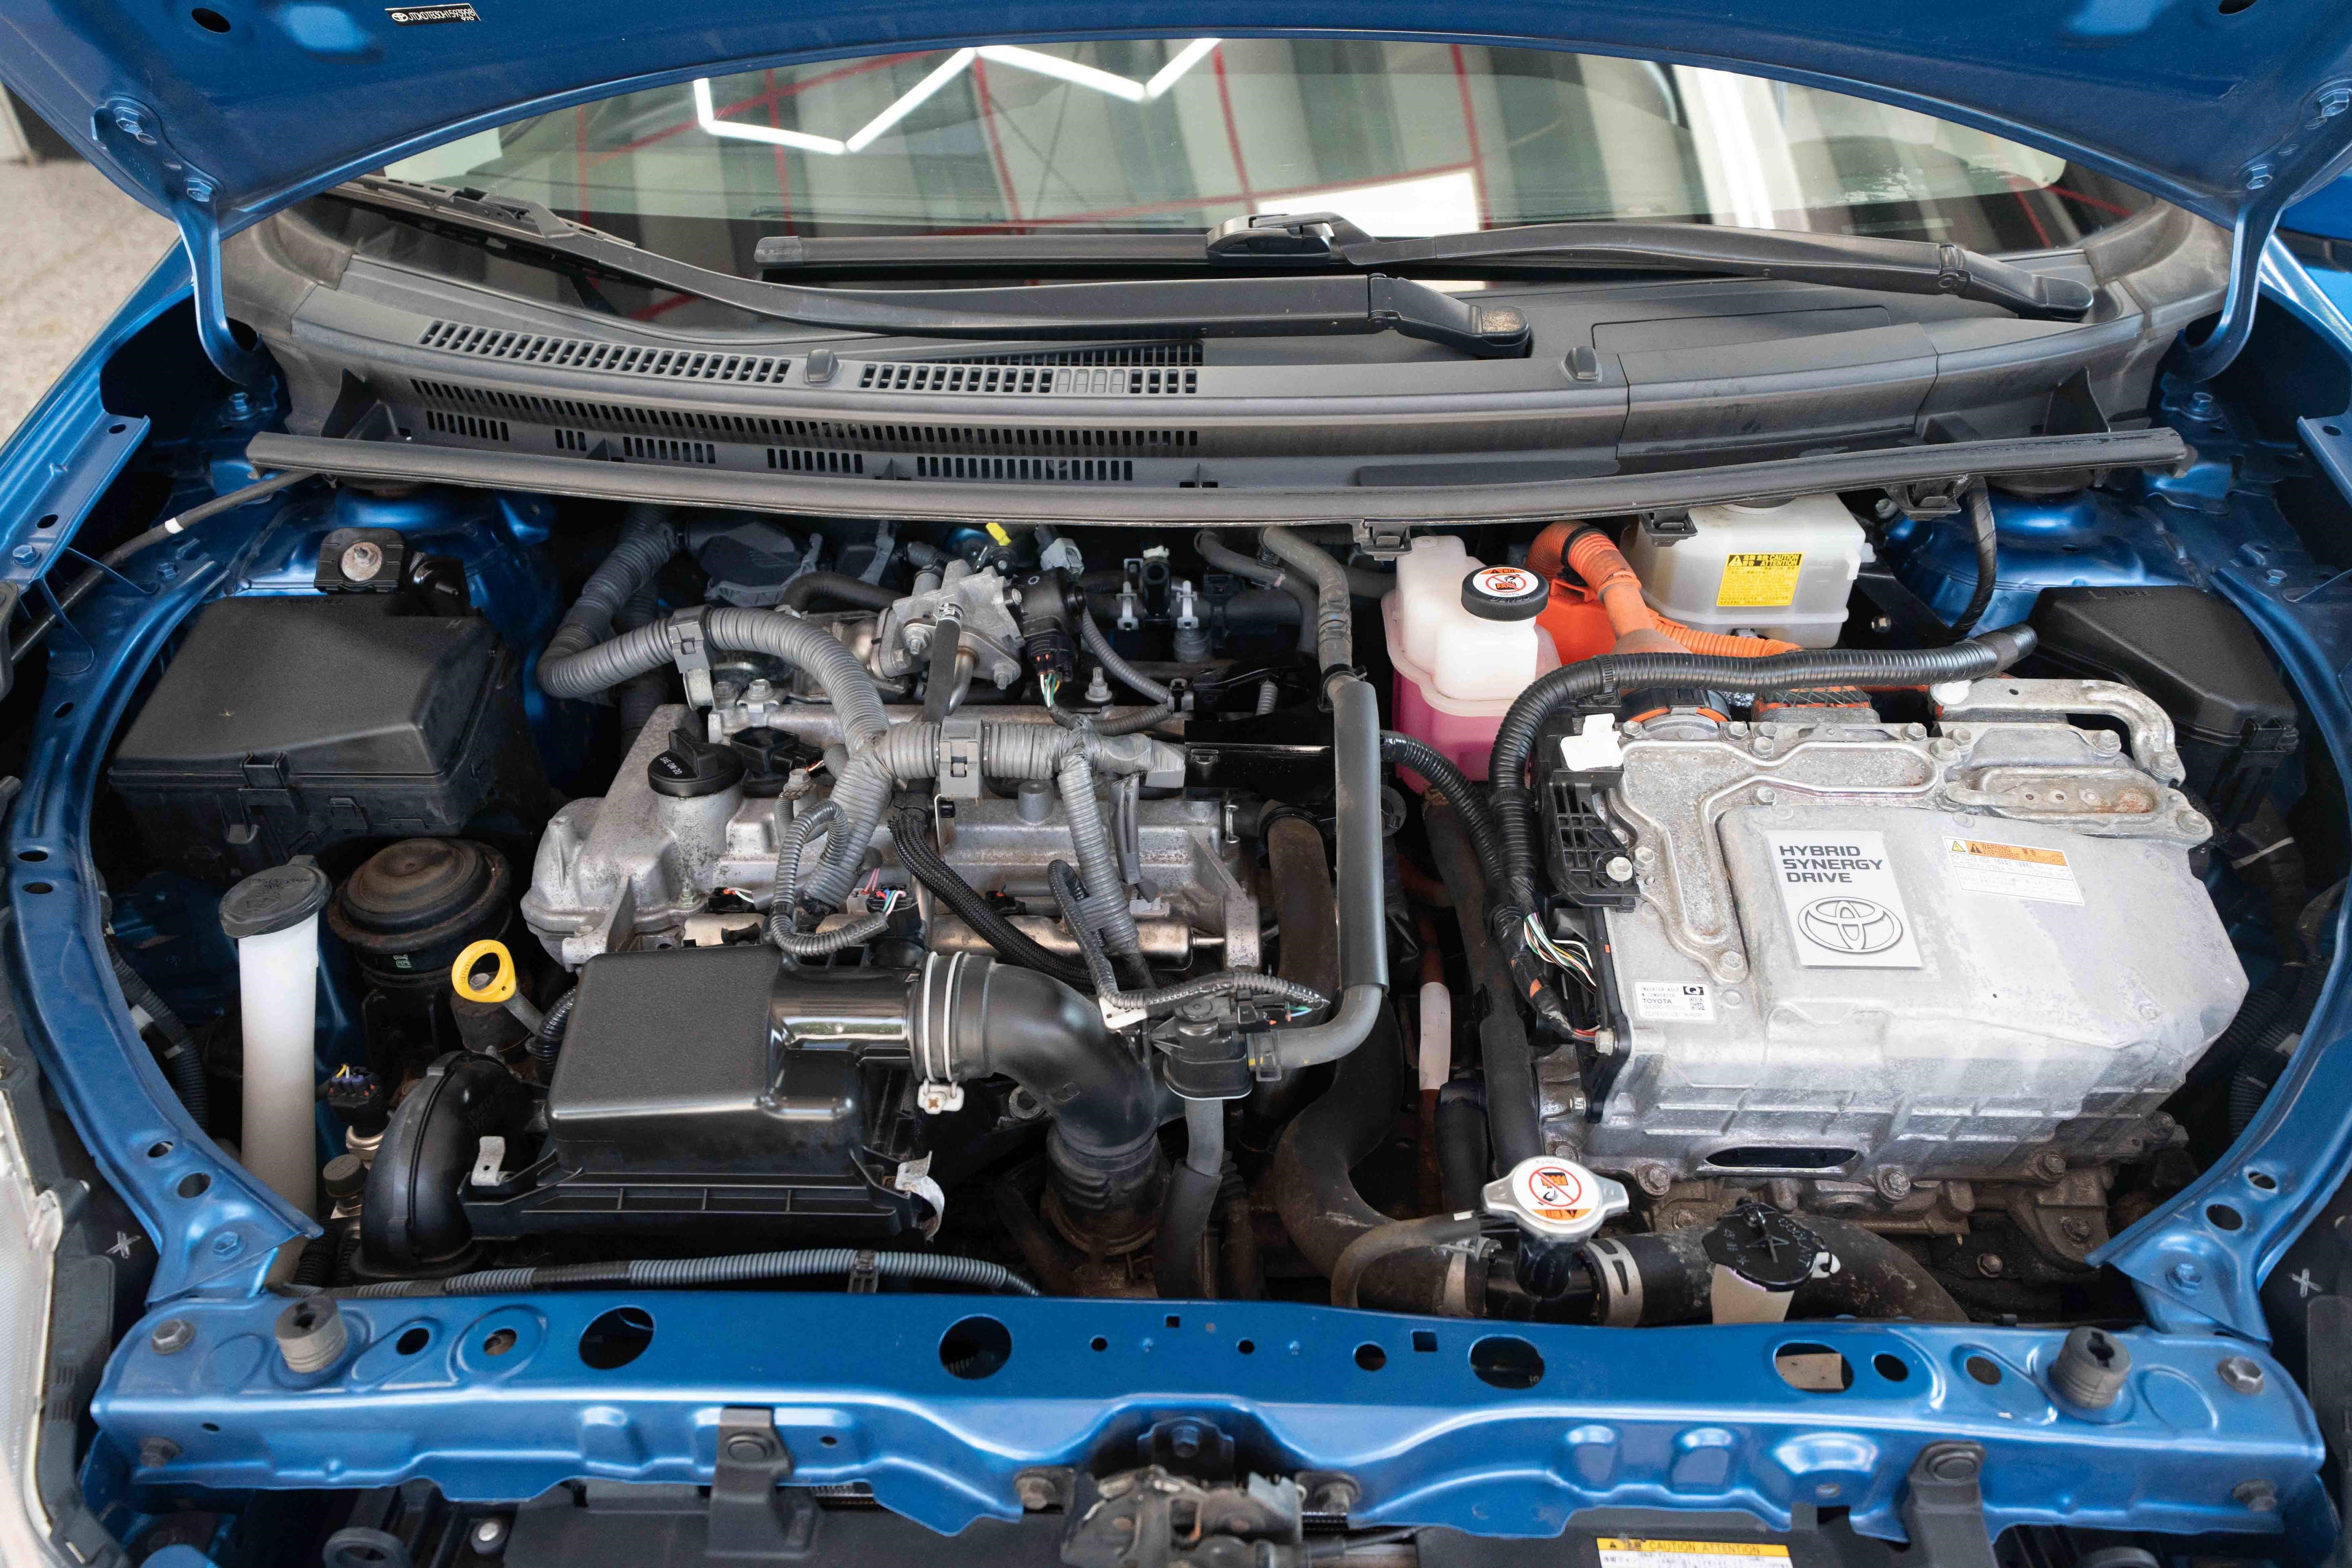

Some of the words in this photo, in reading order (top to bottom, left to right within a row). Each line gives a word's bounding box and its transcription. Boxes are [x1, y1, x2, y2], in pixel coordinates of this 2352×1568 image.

[667, 762, 682, 775] 0W-20
[1779, 846, 1861, 856] HYBRID
[1980, 843, 2011, 853] WARNING
[1783, 859, 1882, 870] SYNERGY
[1786, 872, 1853, 883] DRIVE
[1648, 1541, 1695, 1552] CAUTION
[1702, 1543, 1760, 1554] ATTENTION
